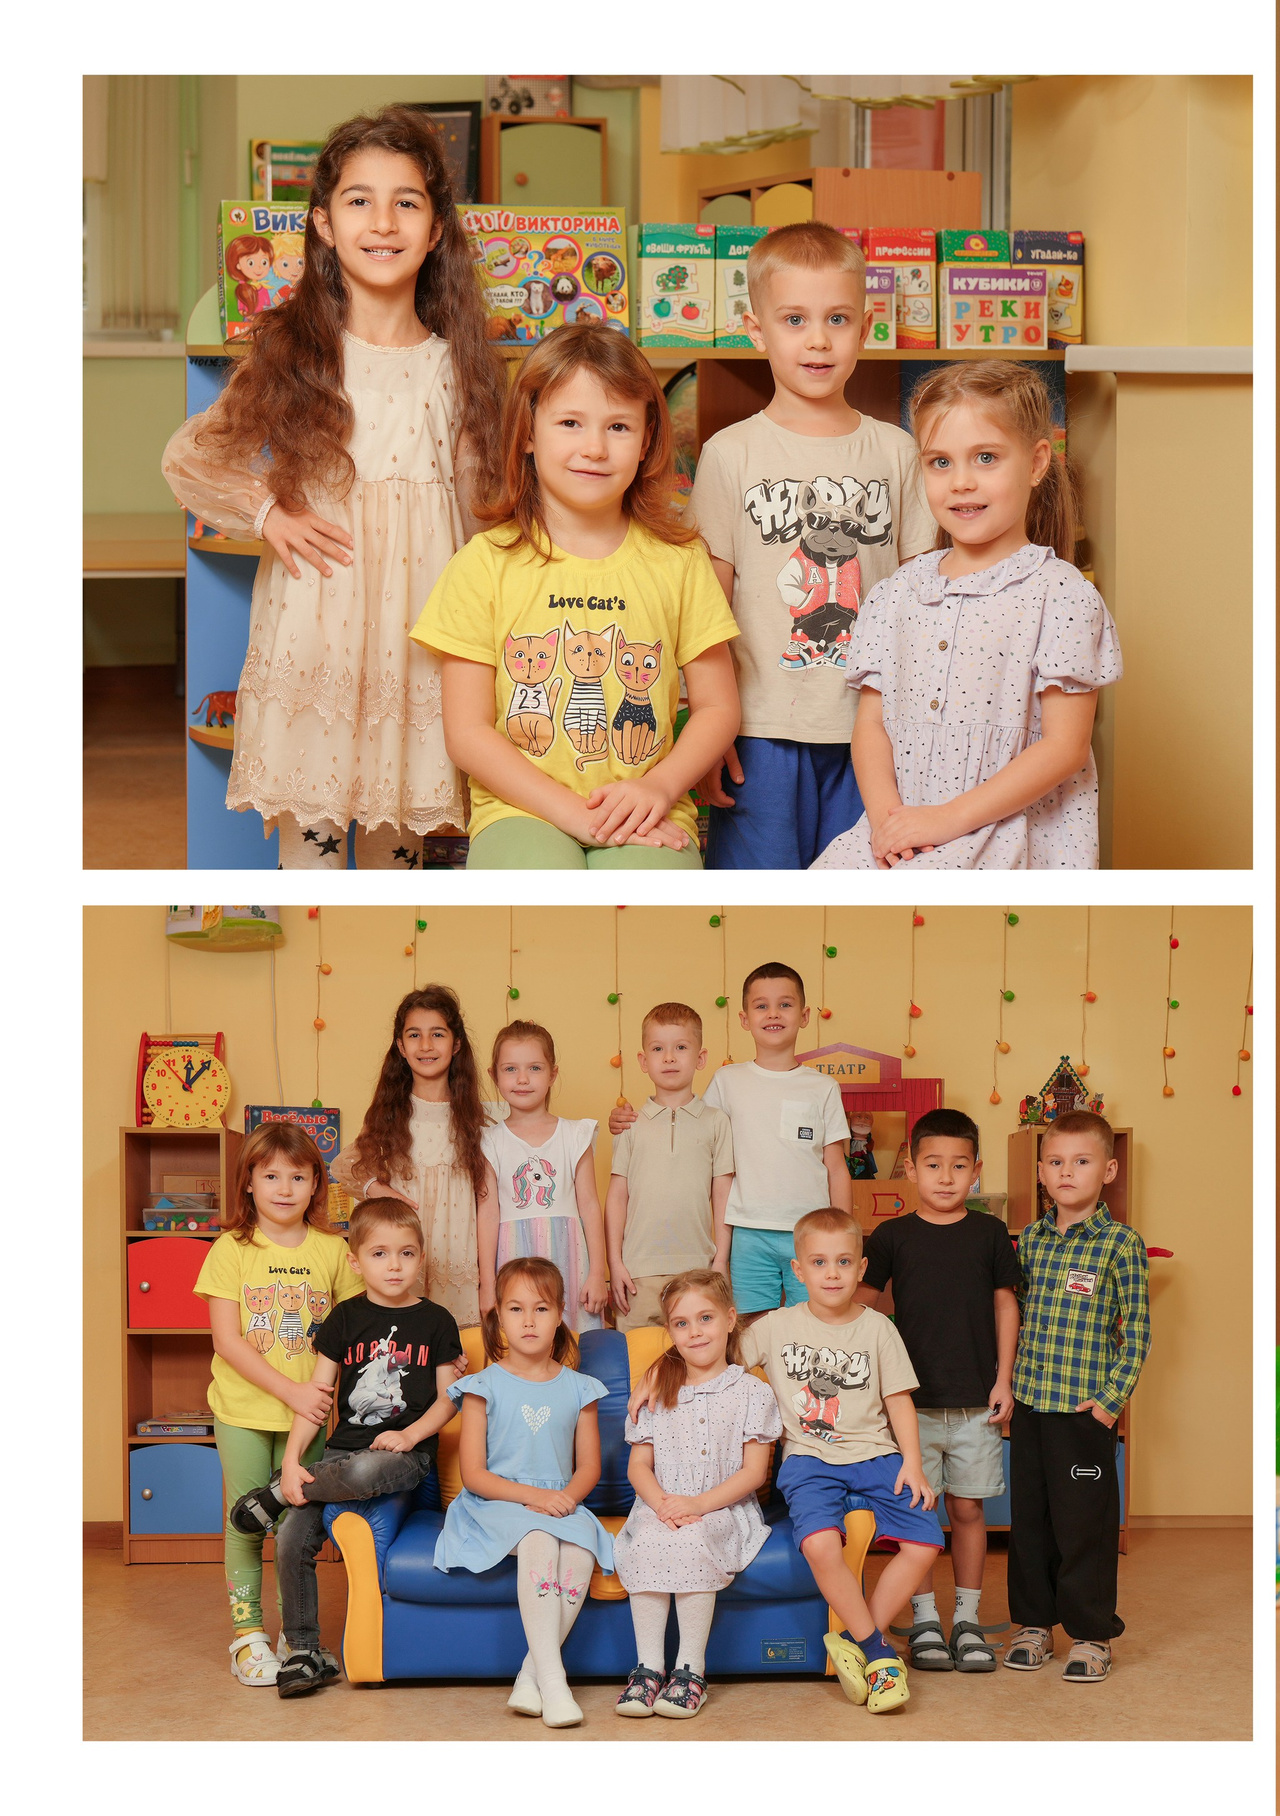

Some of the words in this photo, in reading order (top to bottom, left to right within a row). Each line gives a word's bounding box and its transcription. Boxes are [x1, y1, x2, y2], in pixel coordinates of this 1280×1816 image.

[953, 277, 1030, 291] КУБИКИ
[955, 300, 1041, 319] РЕКИ
[873, 322, 889, 341] 8
[953, 324, 1042, 343] УТРО
[807, 566, 823, 585] A
[548, 594, 584, 608] Love
[587, 595, 626, 611] Cat's
[518, 689, 543, 710] 23
[155, 1069, 166, 1078] 10
[211, 1069, 217, 1078] 2
[816, 1063, 866, 1075] ТЕАТР
[151, 1083, 157, 1091] 9
[216, 1084, 222, 1093] 3
[156, 1098, 162, 1106] 8
[211, 1099, 218, 1107] 4
[169, 1109, 174, 1117] 7
[184, 1113, 190, 1121] 6
[200, 1109, 206, 1117] 5
[261, 1110, 328, 1124] Весёлые
[268, 1265, 288, 1274] Love
[289, 1266, 311, 1275] Cat's
[253, 1315, 267, 1327] 23
[344, 1340, 429, 1367] JORDAN
